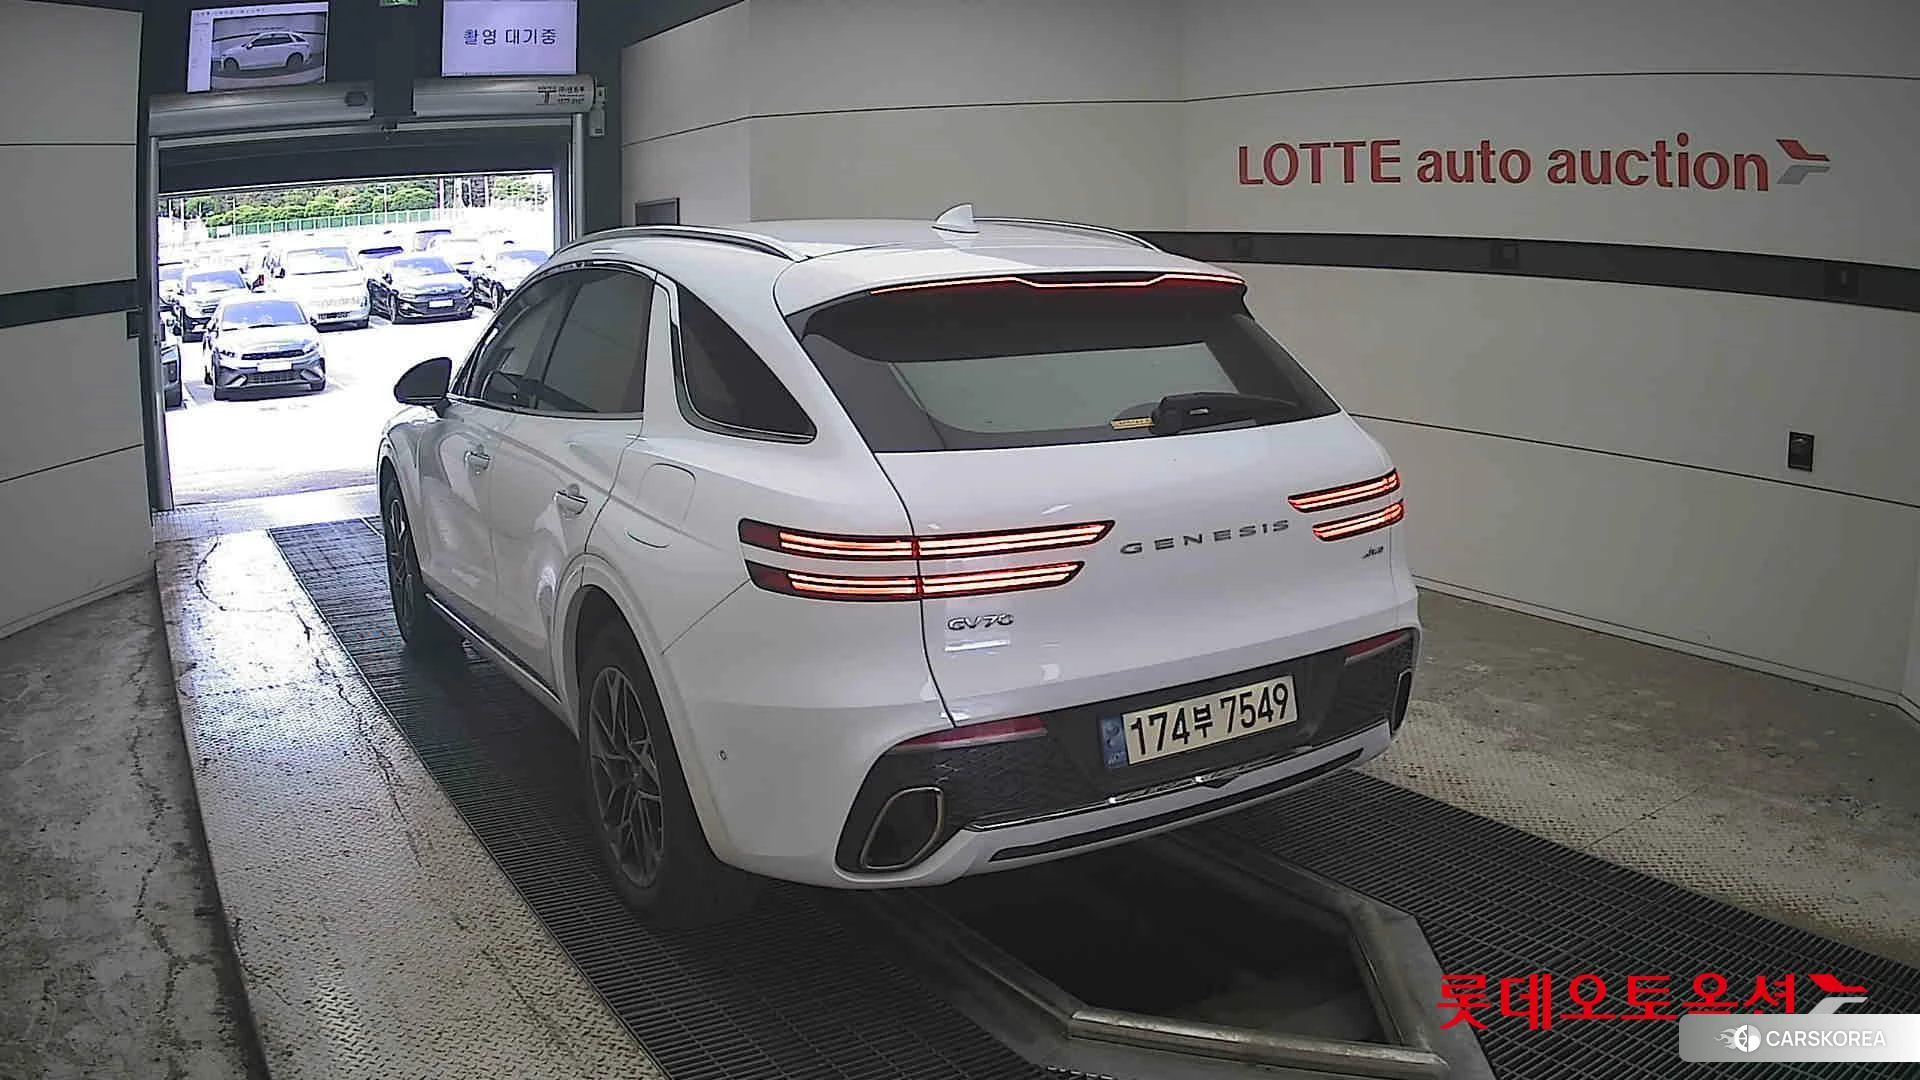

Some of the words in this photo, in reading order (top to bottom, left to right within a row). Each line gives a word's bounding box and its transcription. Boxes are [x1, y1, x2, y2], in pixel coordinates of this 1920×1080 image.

[505, 28, 557, 45] 대기중
[1239, 139, 1400, 185] LOTTE
[1416, 138, 1531, 184] auto
[1547, 132, 1768, 191] auction
[1120, 519, 1289, 555] GENESIS
[946, 614, 1014, 631] GV70
[1131, 702, 1213, 755] 174부
[1220, 683, 1289, 733] 7549
